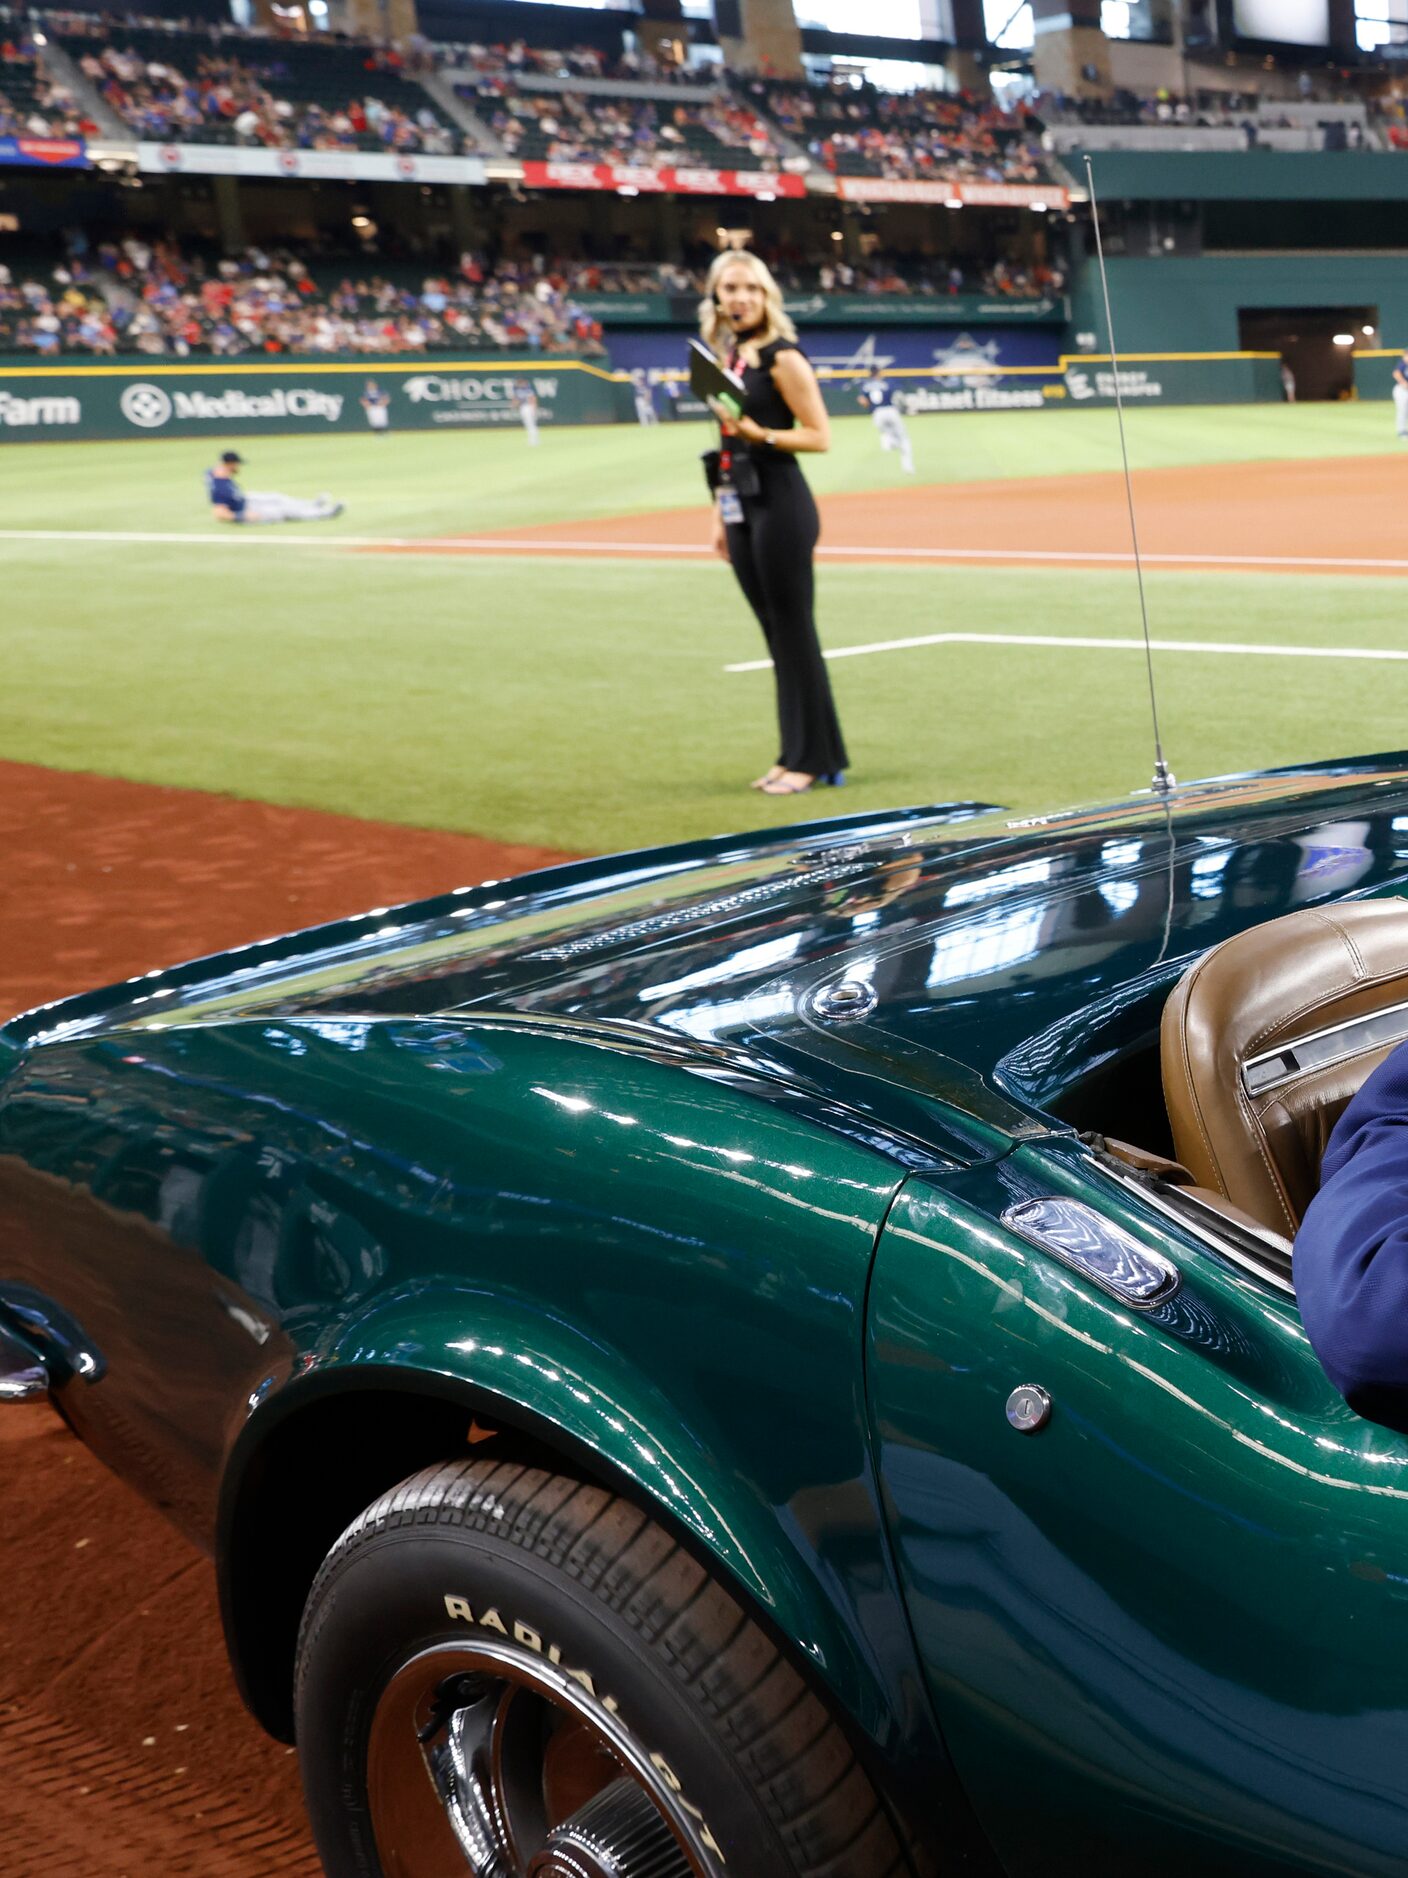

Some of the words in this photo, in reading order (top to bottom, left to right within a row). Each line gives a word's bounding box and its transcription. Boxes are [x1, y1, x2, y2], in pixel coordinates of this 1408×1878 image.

[420, 375, 558, 402] CHOCTW
[173, 389, 287, 418] Medical
[286, 388, 343, 422] City
